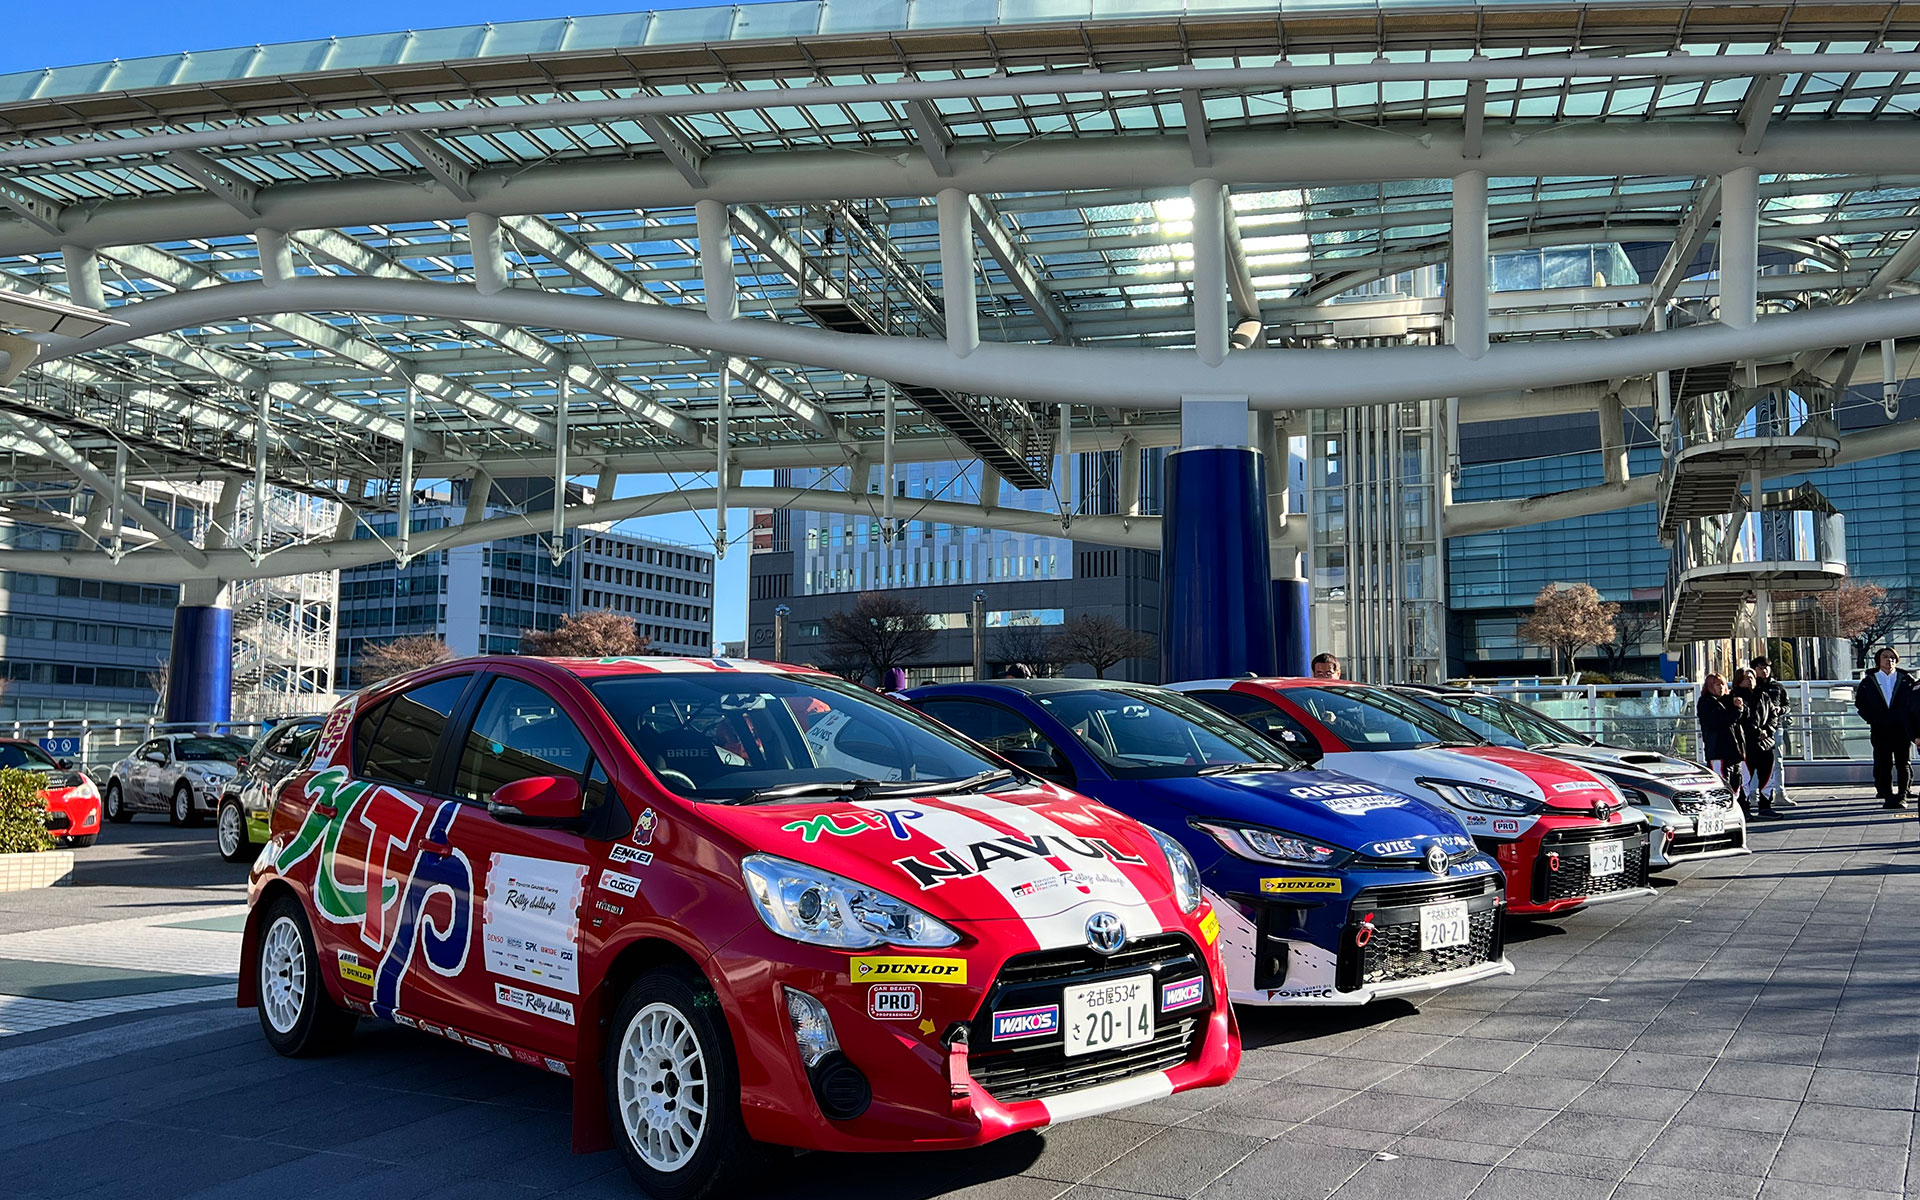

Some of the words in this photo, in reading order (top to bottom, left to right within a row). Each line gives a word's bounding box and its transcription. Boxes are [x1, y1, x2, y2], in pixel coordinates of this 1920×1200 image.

[666, 748, 709, 758] BRIDE
[1373, 840, 1416, 853] CVTEC
[612, 846, 652, 863] ENKEI
[892, 834, 1147, 890] NAVUL
[609, 879, 635, 893] CUSCO
[1012, 885, 1035, 898] GR
[1276, 881, 1335, 889] DUNLOP
[487, 933, 504, 944] DENSO
[525, 941, 538, 953] SPK
[346, 967, 372, 981] DUNLOP
[874, 964, 959, 975] DUNLOP
[499, 991, 511, 1002] GR
[878, 994, 911, 1009] PRO
[1086, 983, 1136, 1007] 名古屋534
[1085, 1003, 1149, 1047] 20-14
[1072, 1023, 1081, 1041] さ
